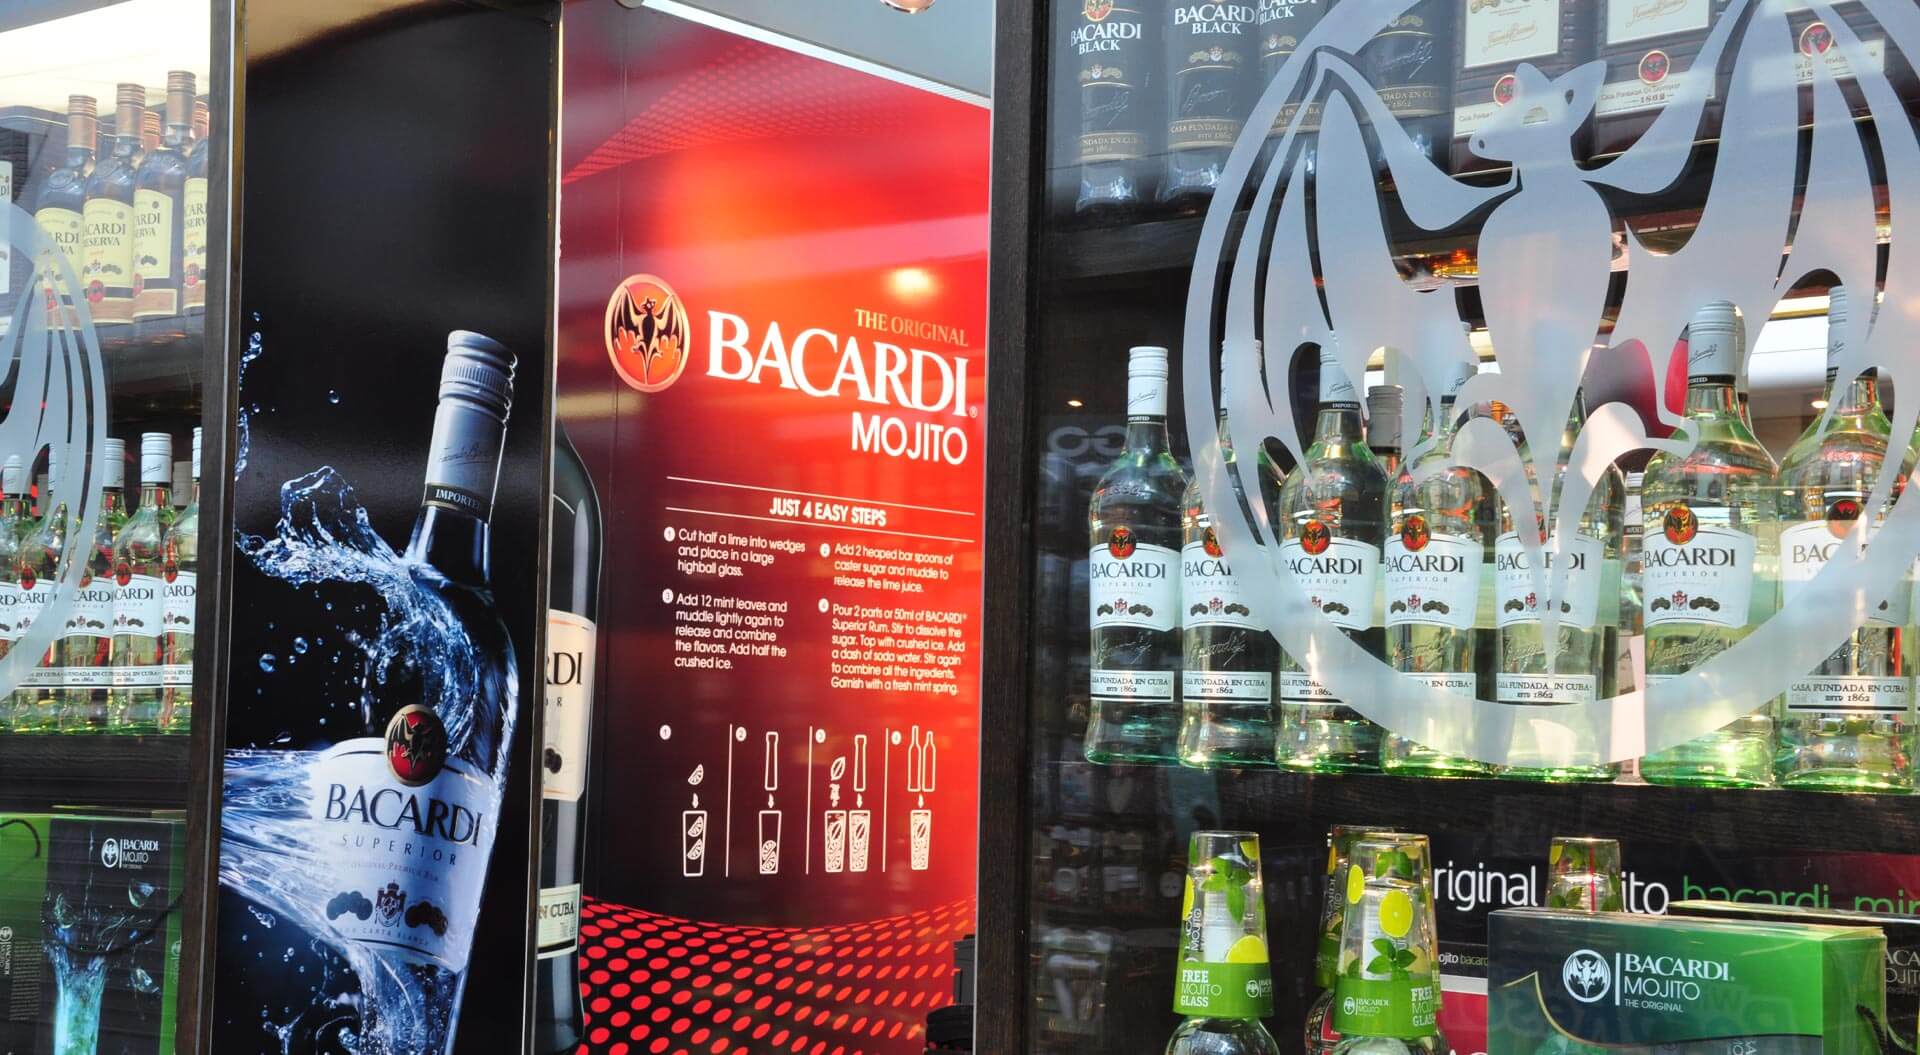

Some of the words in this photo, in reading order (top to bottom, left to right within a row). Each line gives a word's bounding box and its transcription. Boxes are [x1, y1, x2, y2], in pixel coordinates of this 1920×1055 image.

[1174, 4, 1259, 25] BACARDI
[1259, 5, 1295, 25] BLACK
[1070, 23, 1141, 47] BACARDI
[1192, 23, 1242, 35] BLACK
[1079, 39, 1120, 55] BLACK
[854, 308, 888, 332] THE
[891, 316, 969, 347] ORIGINAL
[852, 411, 968, 465] MOJITO
[769, 497, 801, 517] JUST
[802, 501, 812, 518] 4
[815, 502, 848, 522] EASY
[851, 506, 887, 527] STEPS
[678, 528, 697, 541] Cut
[699, 531, 717, 544] half
[719, 535, 727, 545] a
[728, 533, 748, 547] lime
[750, 536, 767, 548] into
[769, 539, 806, 554] wedges
[678, 545, 698, 557] and
[700, 547, 728, 560] place
[731, 549, 739, 560] in
[741, 552, 749, 562] a
[750, 551, 775, 566] large
[835, 543, 854, 556] Add
[855, 545, 861, 556] 2
[863, 545, 897, 561] heaped
[899, 550, 913, 561] bar
[914, 553, 943, 564] spoons
[944, 554, 954, 565] of
[1385, 553, 1465, 573] BACARDI
[1644, 547, 1735, 568] BACARDI
[678, 560, 717, 575] highball
[718, 564, 744, 578] glass.
[834, 560, 862, 573] caster
[863, 563, 887, 576] sugar
[888, 565, 905, 576] and
[907, 566, 938, 579] muddle
[940, 569, 949, 580] to
[1092, 562, 1166, 579] BACARDI
[1184, 560, 1232, 577] BACA
[1285, 557, 1362, 575] ACARDI
[834, 575, 865, 588] release
[867, 577, 881, 590] the
[883, 578, 900, 591] lime
[901, 581, 924, 593] juice.
[676, 593, 698, 606] Add
[701, 594, 712, 607] 12
[714, 596, 734, 609] mint
[736, 598, 767, 611] leaves
[768, 601, 788, 613] and
[833, 603, 853, 616] Pour
[854, 605, 860, 617] 2
[861, 607, 882, 620] parts
[884, 609, 893, 619] or
[894, 608, 914, 620] 50ml
[915, 610, 925, 621] of
[676, 610, 714, 622] muddle
[715, 611, 743, 627] lightly
[744, 614, 772, 628] again
[774, 616, 784, 628] to
[832, 618, 867, 633] Superior
[869, 620, 889, 634] Rum.
[891, 622, 904, 634] Stir
[905, 623, 914, 635] to
[915, 624, 947, 637] dissolve
[948, 627, 962, 638] the
[675, 624, 711, 638] release
[713, 627, 733, 639] and
[735, 628, 777, 642] combine
[675, 639, 691, 652] the
[694, 640, 727, 654] flavors.
[729, 642, 750, 655] Add
[752, 643, 770, 657] half
[771, 645, 787, 658] the
[832, 634, 858, 648] sugar.
[860, 634, 876, 648] Top
[878, 636, 895, 648] with
[896, 638, 929, 650] crushed
[931, 640, 944, 651] ice.
[947, 641, 965, 652] Add
[674, 656, 714, 669] crushed
[715, 657, 733, 670] ice.
[832, 649, 839, 659] a
[840, 648, 861, 660] dash
[863, 649, 873, 661] of
[873, 651, 895, 662] soda
[897, 653, 922, 664] water.
[924, 653, 936, 665] Stir
[937, 655, 961, 668] again
[832, 662, 841, 674] to
[842, 663, 881, 676] combine
[883, 664, 893, 677] all
[894, 665, 908, 677] the
[909, 666, 955, 680] ingredients.
[831, 676, 864, 689] Garnish
[865, 678, 883, 690] with
[884, 681, 891, 690] a
[892, 679, 912, 691] fresh
[914, 681, 931, 692] mint
[1147, 678, 1169, 686] CUBA
[1432, 680, 1444, 688] EN
[1813, 683, 1865, 693] FUNDADA
[1868, 684, 1881, 693] EN
[1847, 694, 1870, 702] 1862
[325, 783, 482, 847] BACARDI
[123, 839, 159, 852] BACARDI
[342, 834, 456, 865] SUPERIOR
[122, 851, 148, 864] MOJITO
[1434, 861, 1538, 912] riginal
[1621, 871, 1670, 915] ito
[1855, 889, 1920, 915] min
[550, 899, 575, 918] CUBA
[1439, 953, 1459, 966] ojito
[1624, 953, 1729, 981] BACARDI
[1183, 969, 1209, 983] FREE
[1182, 983, 1222, 996] MOJITO
[1624, 975, 1700, 1000] MOJITO
[1181, 995, 1209, 1008] GLASS
[1624, 998, 1639, 1008] THE
[1641, 1000, 1684, 1013] ORIGINAL
